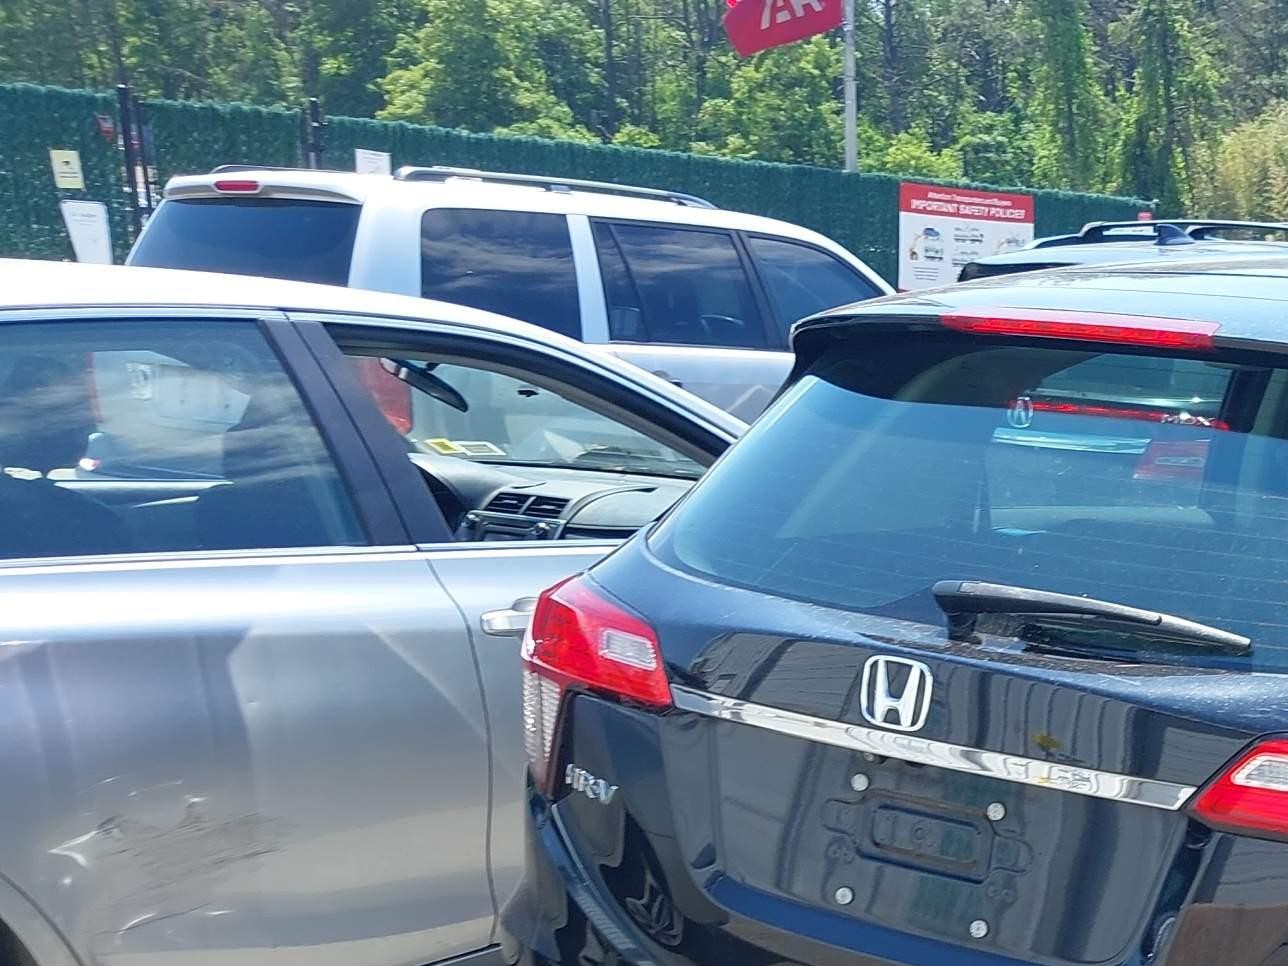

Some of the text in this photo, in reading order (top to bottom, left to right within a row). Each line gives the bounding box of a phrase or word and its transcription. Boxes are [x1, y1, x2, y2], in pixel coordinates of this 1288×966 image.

[910, 199, 958, 213] IMPORTANT
[959, 203, 988, 217] SAFETY
[1161, 412, 1215, 426] MDX
